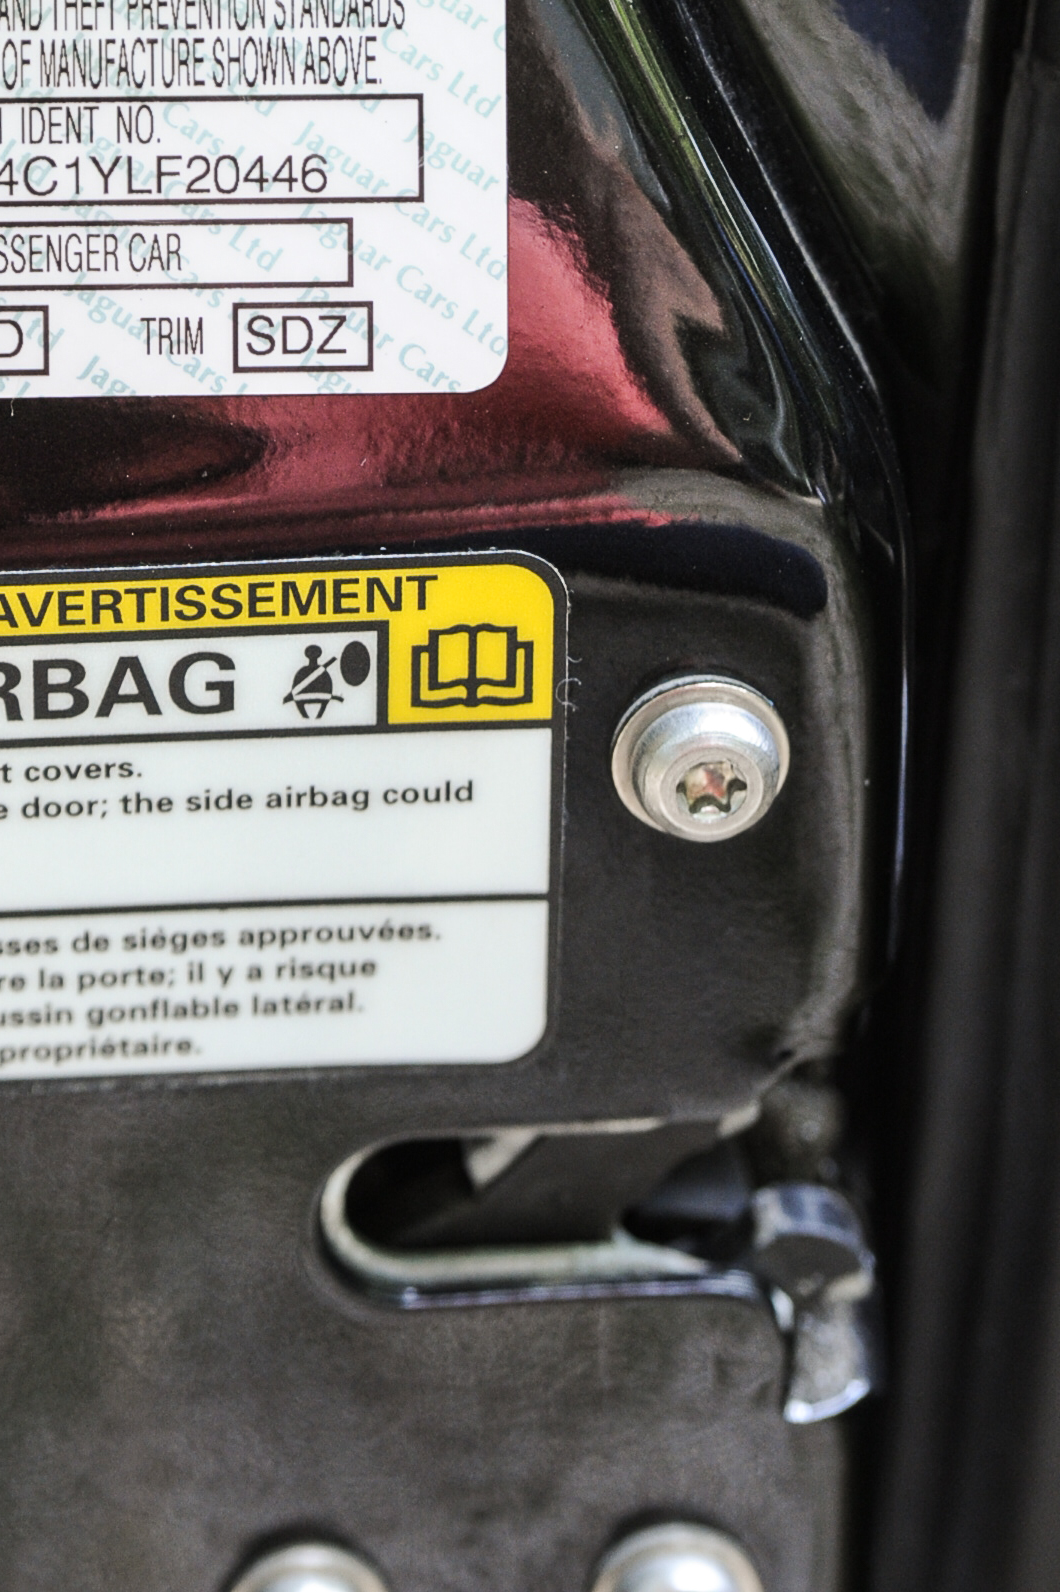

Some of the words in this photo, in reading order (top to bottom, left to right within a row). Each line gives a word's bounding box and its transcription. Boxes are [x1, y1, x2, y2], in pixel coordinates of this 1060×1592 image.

[2, 38, 32, 91] OF
[40, 37, 206, 90] MANUFACTURE
[212, 36, 296, 88] SHOWN
[303, 35, 382, 86] ABOVE.
[21, 105, 100, 145] IDENT
[116, 104, 161, 145] NO.
[128, 232, 182, 273] CAR
[139, 316, 204, 356] TRIM
[246, 314, 347, 356] SDZ
[24, 762, 142, 783] covers.
[21, 796, 107, 819] door;
[120, 792, 174, 814] the
[186, 788, 253, 812] side
[266, 785, 370, 811] airbag
[382, 780, 473, 805] could
[72, 931, 110, 952] de
[239, 919, 440, 948] approuvées.
[39, 969, 65, 989] la
[78, 967, 173, 993] porte;
[188, 962, 204, 983] il
[218, 967, 233, 987] y
[247, 966, 262, 981] a
[276, 956, 377, 984] risque
[86, 997, 239, 1028] gonflable
